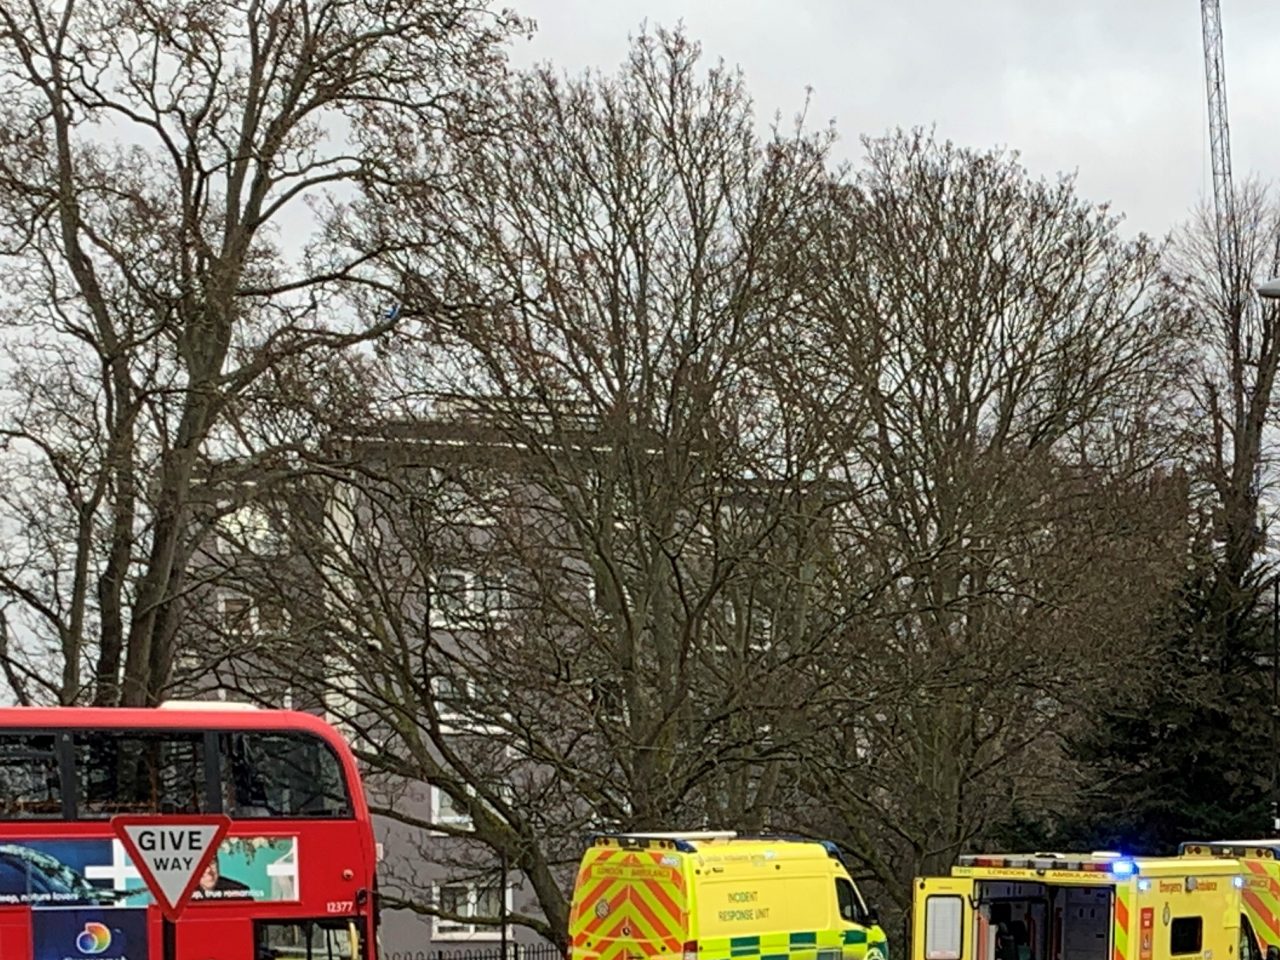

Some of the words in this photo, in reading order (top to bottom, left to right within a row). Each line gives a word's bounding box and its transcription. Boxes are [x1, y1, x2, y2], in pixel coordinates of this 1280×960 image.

[138, 831, 202, 851] GIVE
[153, 857, 193, 871] WAY
[987, 869, 1025, 877] LONDON
[1051, 871, 1108, 879] AMBULANCE
[52, 891, 79, 901] lovers
[204, 889, 222, 898] true
[223, 889, 265, 897] romantics
[728, 891, 758, 904] INCIDENT
[326, 902, 354, 912] 12377
[718, 910, 754, 922] RESPONSE
[755, 908, 770, 919] UNIT
